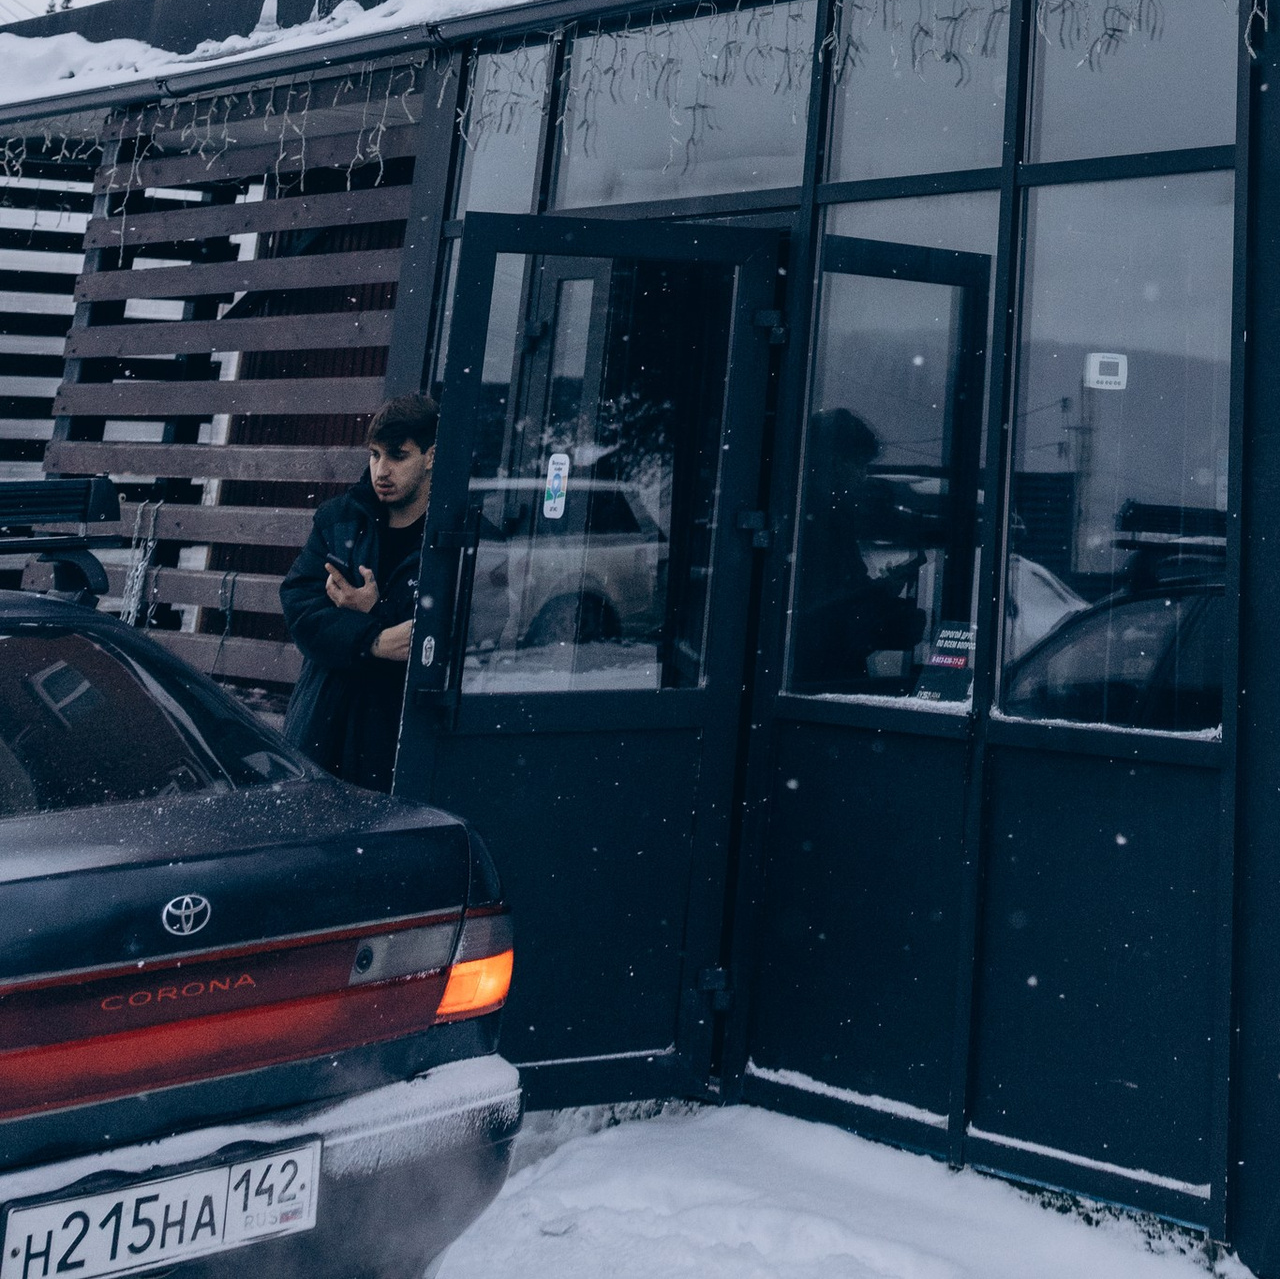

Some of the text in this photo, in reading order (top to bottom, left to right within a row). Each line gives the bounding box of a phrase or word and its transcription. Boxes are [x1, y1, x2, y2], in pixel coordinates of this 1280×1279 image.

[100, 973, 256, 1011] CORONA
[232, 1158, 299, 1212] 142
[244, 1211, 279, 1229] RUS
